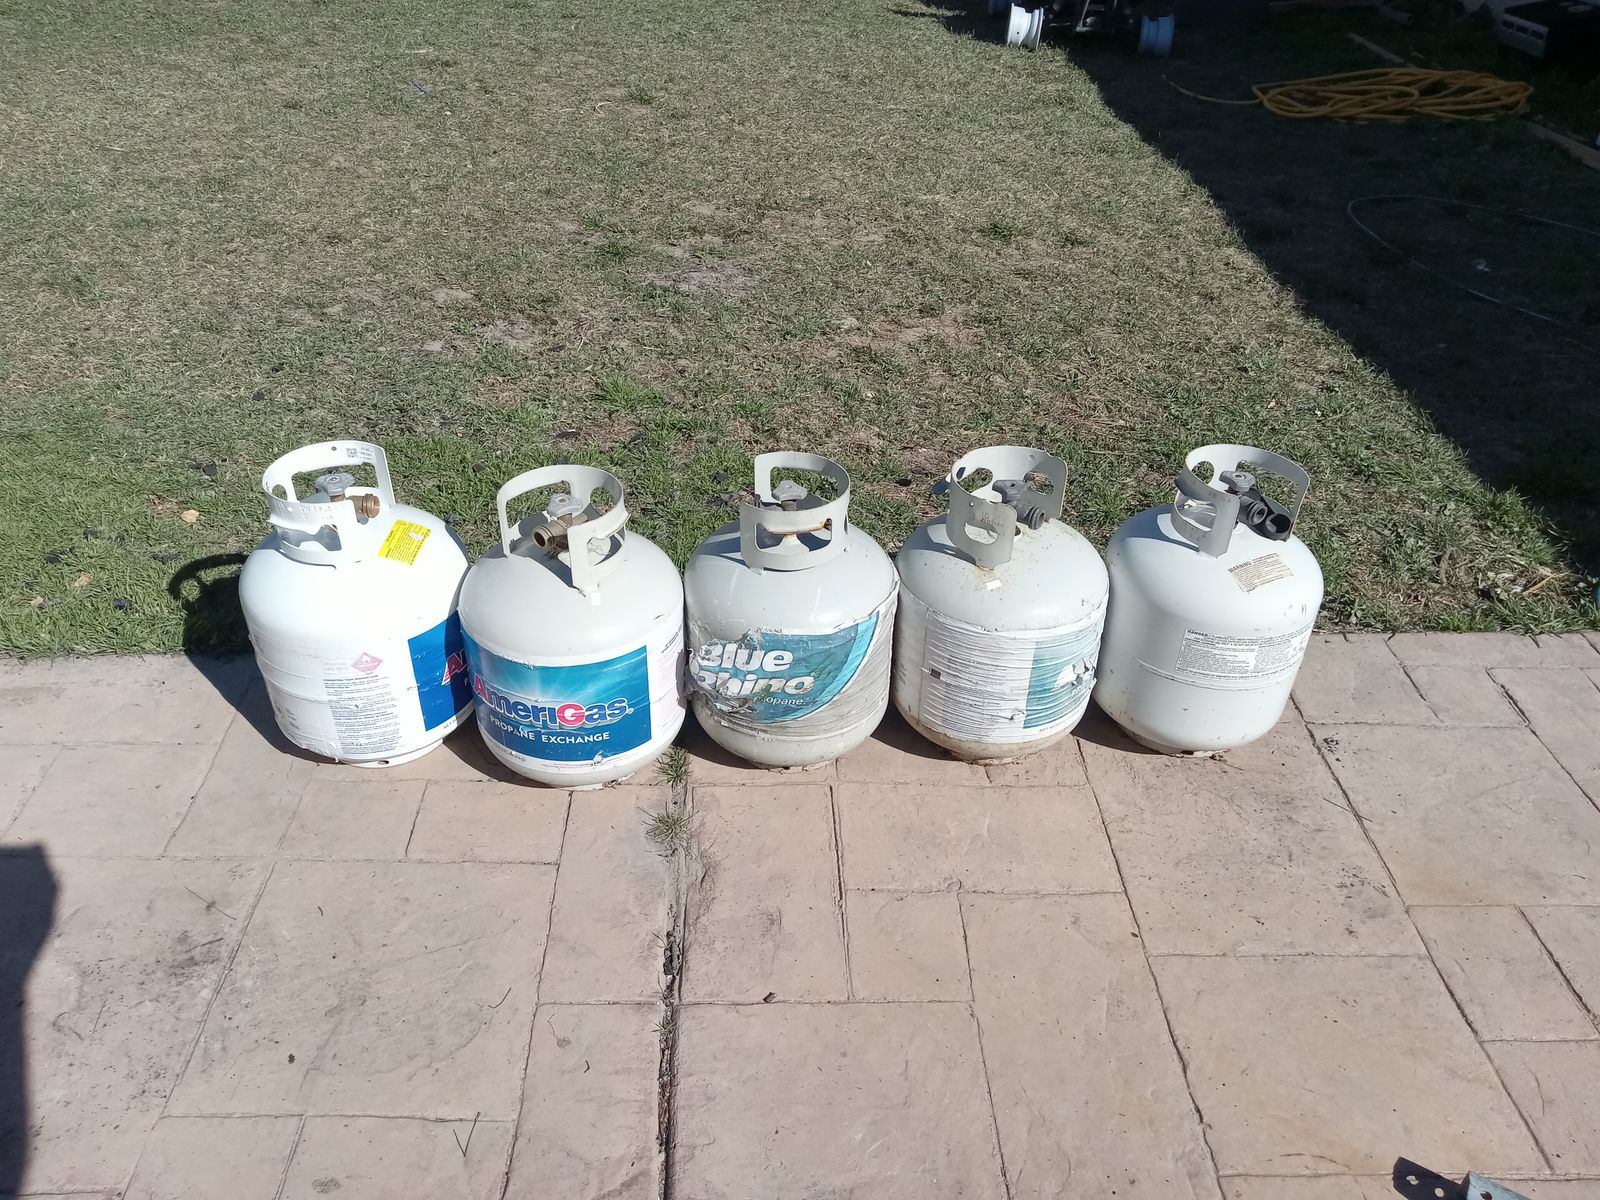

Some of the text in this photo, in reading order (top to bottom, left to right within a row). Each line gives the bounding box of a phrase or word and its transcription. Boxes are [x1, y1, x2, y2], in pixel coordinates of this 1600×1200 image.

[698, 643, 795, 672] Blue
[697, 670, 816, 698] Rhino
[473, 672, 629, 728] AmeriGas
[489, 714, 535, 741] PROPANE
[541, 730, 611, 745] EXCHANGE
